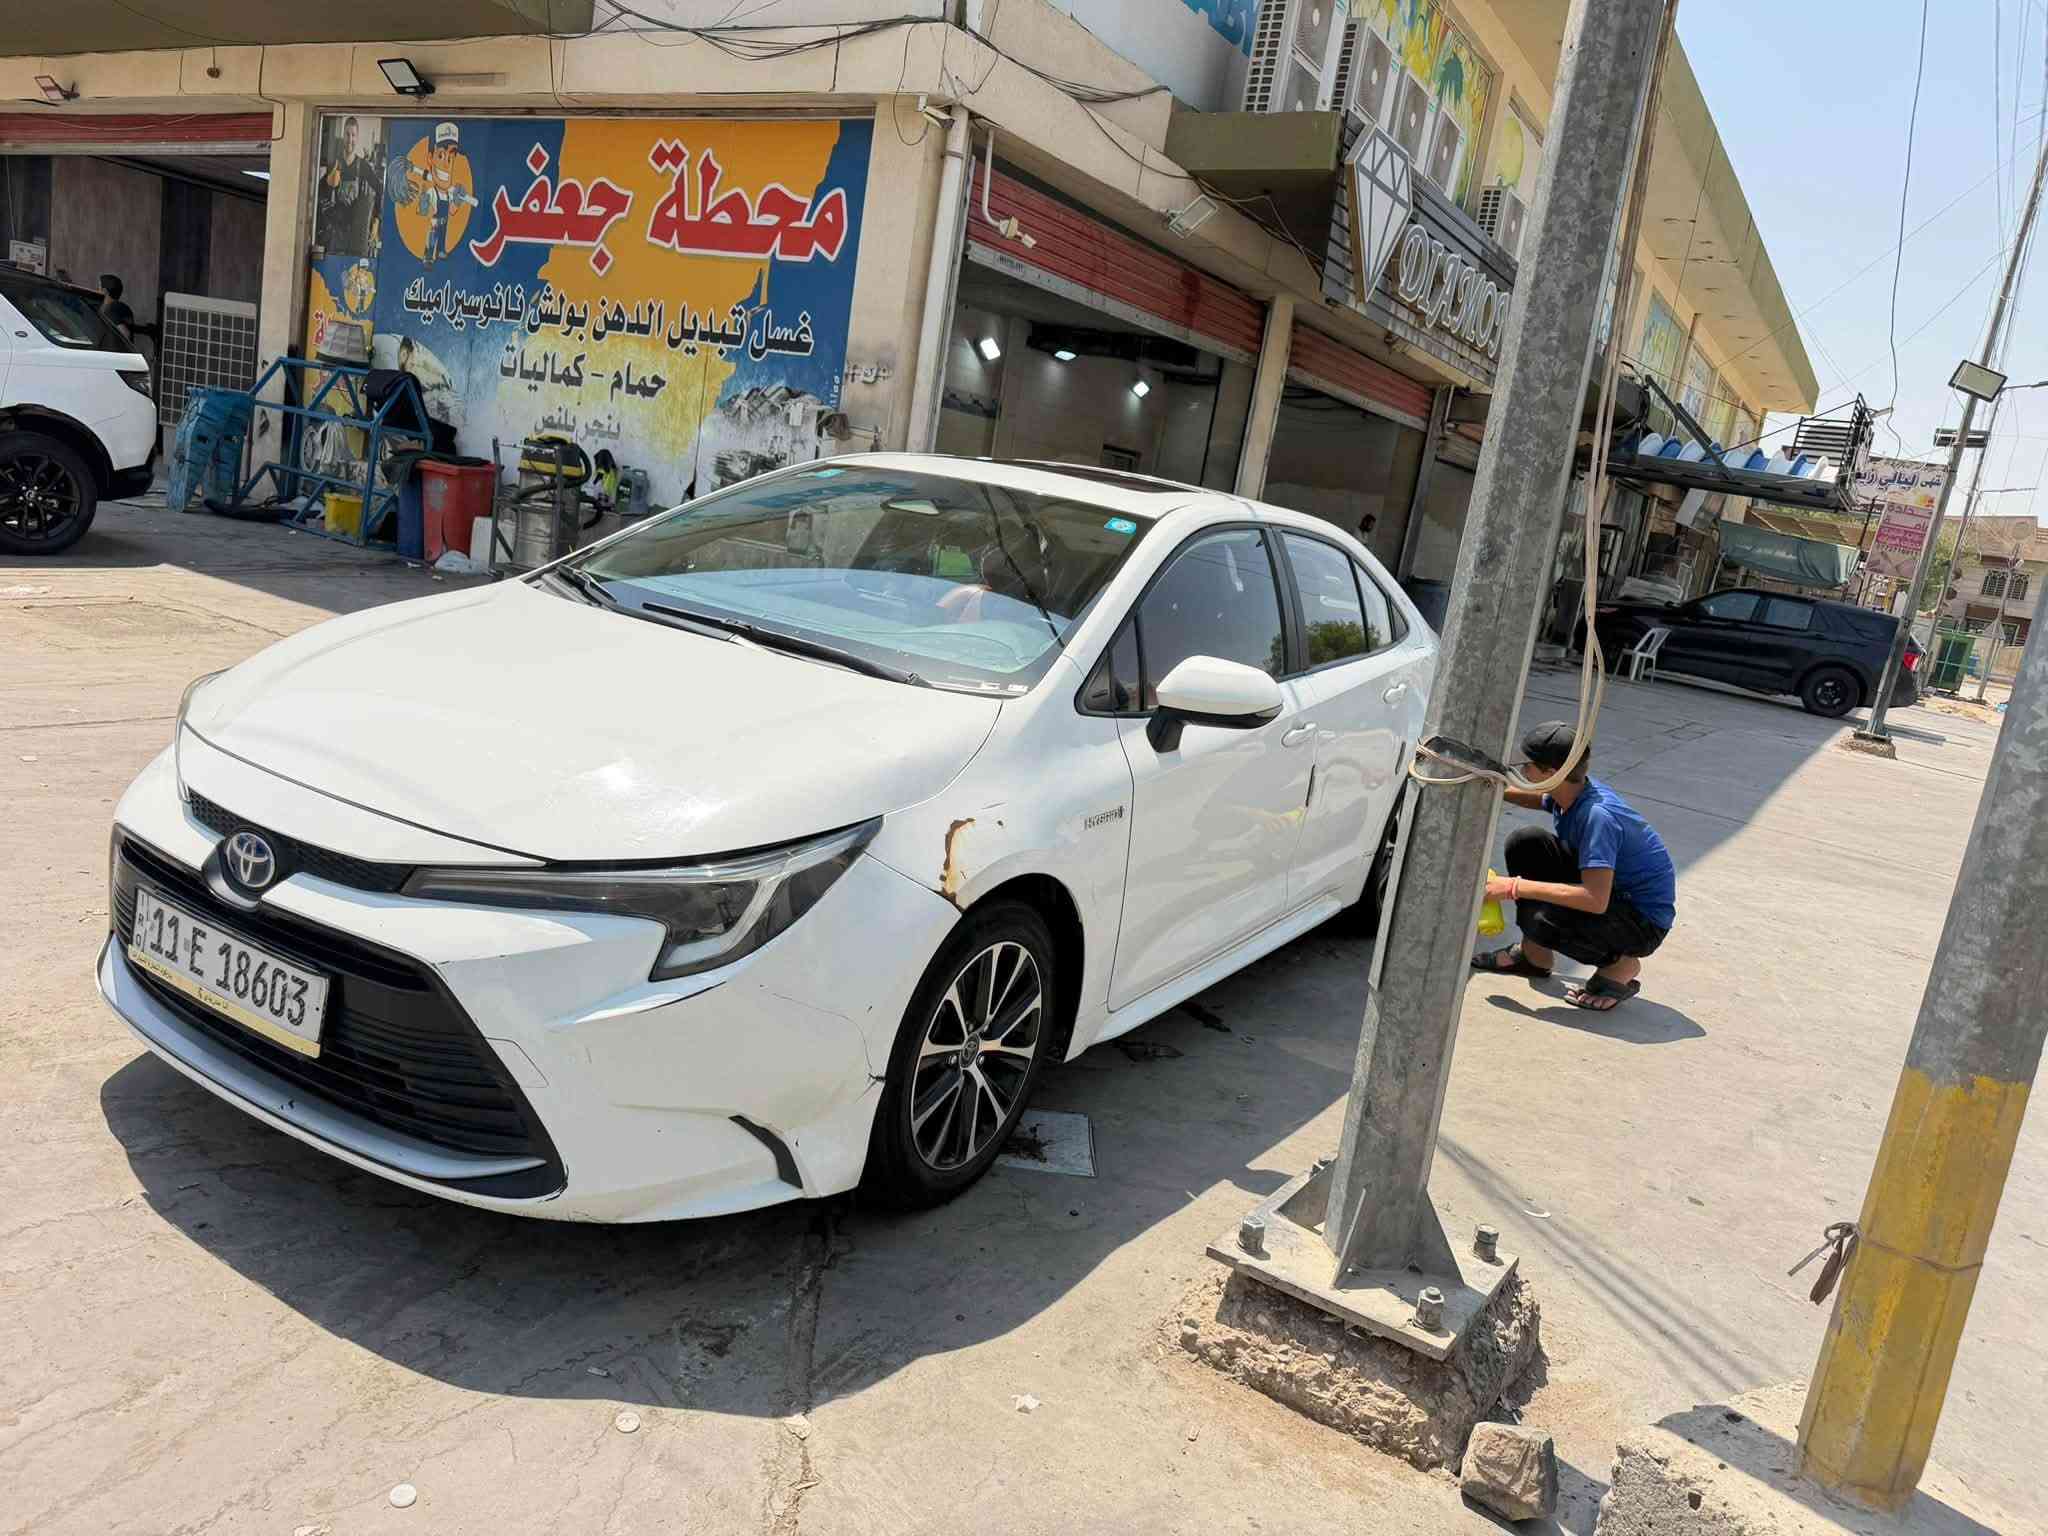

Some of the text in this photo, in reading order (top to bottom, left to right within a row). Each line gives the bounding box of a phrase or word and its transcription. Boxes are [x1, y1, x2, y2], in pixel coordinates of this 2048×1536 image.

[469, 137, 848, 276] محطة جعفر
[527, 282, 588, 342] بولش
[592, 296, 664, 342] الدهن
[667, 299, 747, 358] تبديل
[749, 309, 814, 361] غسل
[500, 343, 586, 392] كماليات
[610, 361, 667, 402] حمام
[149, 907, 181, 963] 11
[188, 926, 207, 977] E
[215, 942, 309, 1027] 18603
